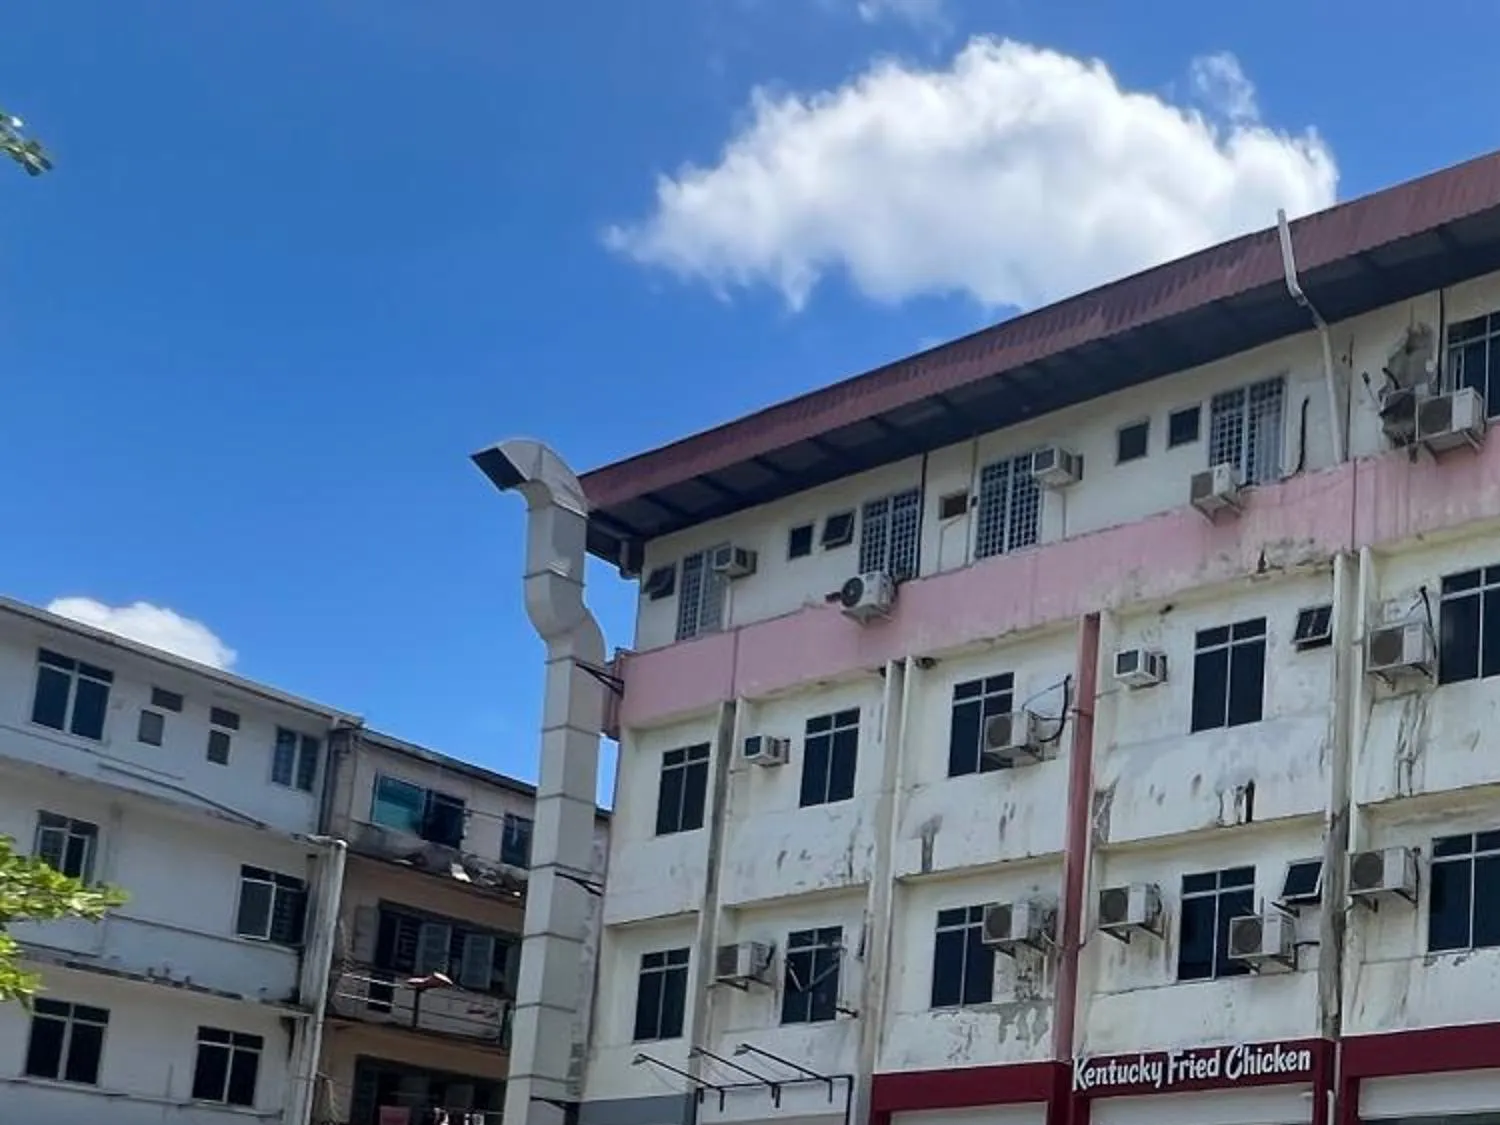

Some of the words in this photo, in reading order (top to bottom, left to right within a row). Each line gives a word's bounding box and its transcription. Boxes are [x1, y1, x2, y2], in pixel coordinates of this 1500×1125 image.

[1072, 1055, 1163, 1092] Kentucky
[1167, 1049, 1221, 1085] Fried
[1224, 1043, 1311, 1081] Chicken
